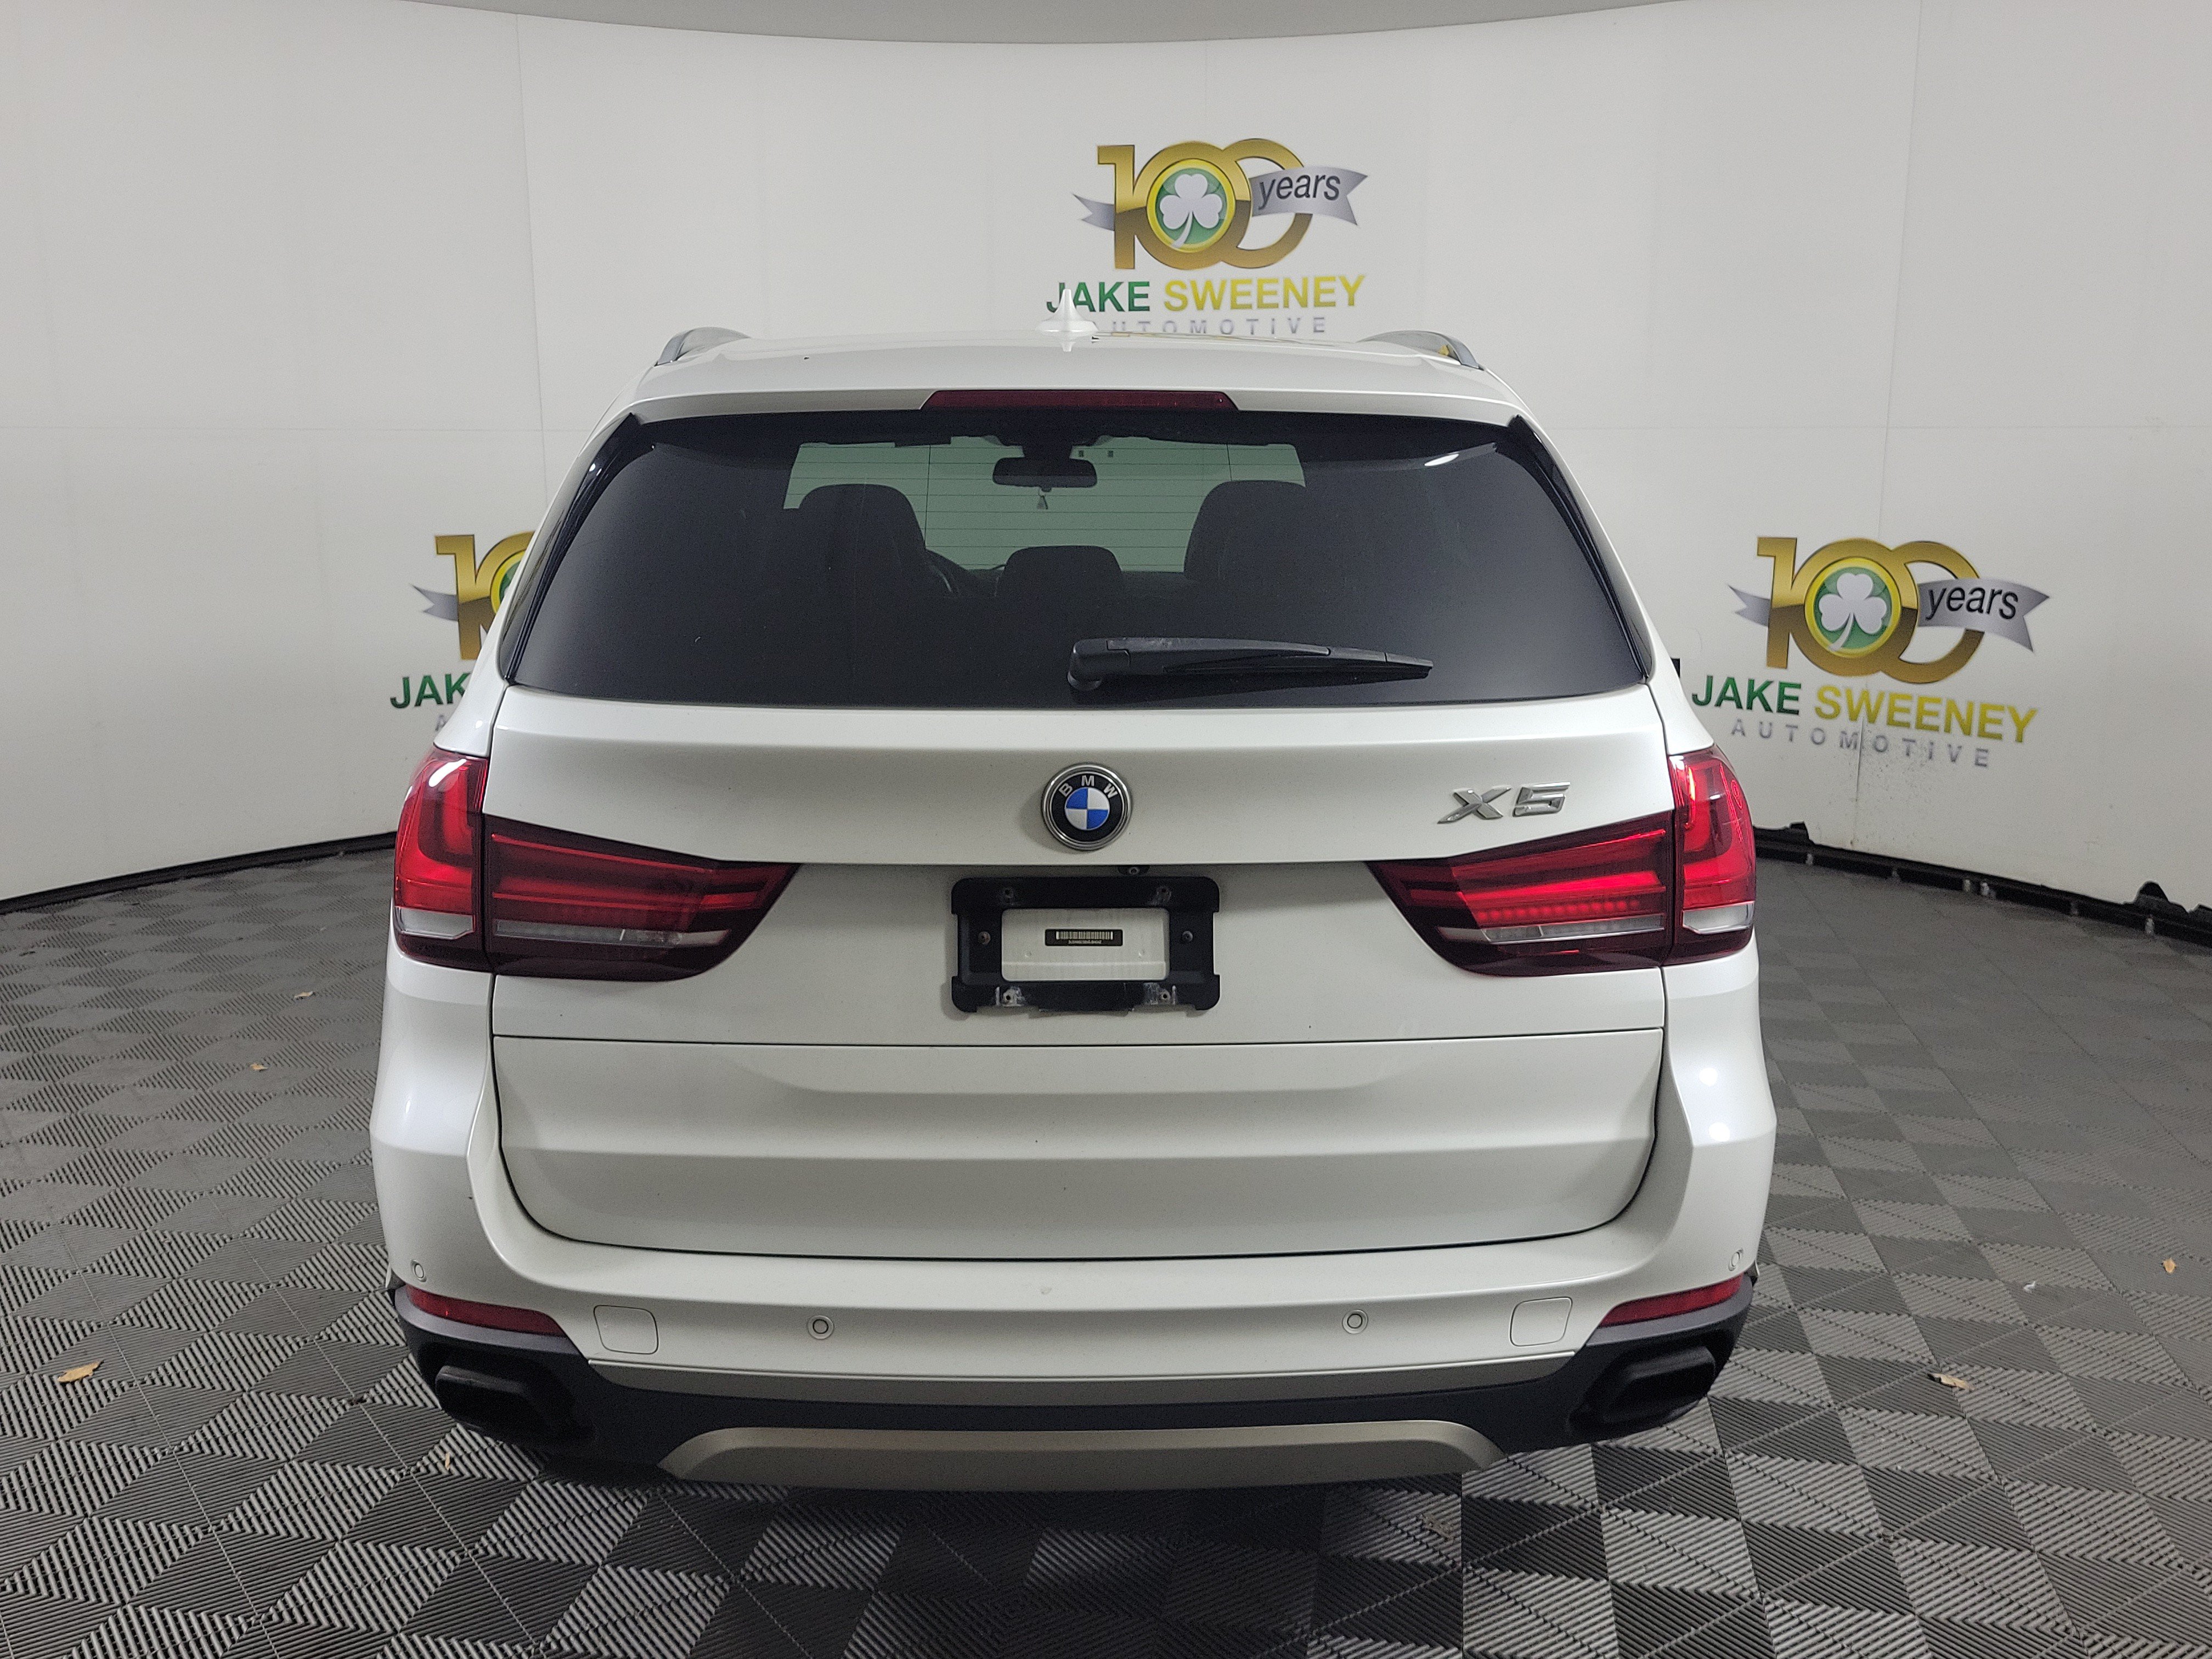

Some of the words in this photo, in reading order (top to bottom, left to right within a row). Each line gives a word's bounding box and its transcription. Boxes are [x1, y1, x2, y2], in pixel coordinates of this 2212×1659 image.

[1097, 138, 1313, 270] 100
[1258, 173, 1342, 210] years
[1164, 275, 1366, 312] SWEENEY
[1757, 537, 1985, 684] 100
[1925, 583, 2019, 620] years
[390, 672, 472, 709] JAK
[1691, 675, 1802, 715] JAKE
[1814, 685, 2039, 743] SWEENEY
[1730, 718, 1989, 767] AUTOMOTIVE
[1058, 775, 1119, 799] BMW
[1436, 781, 1571, 824] X5
